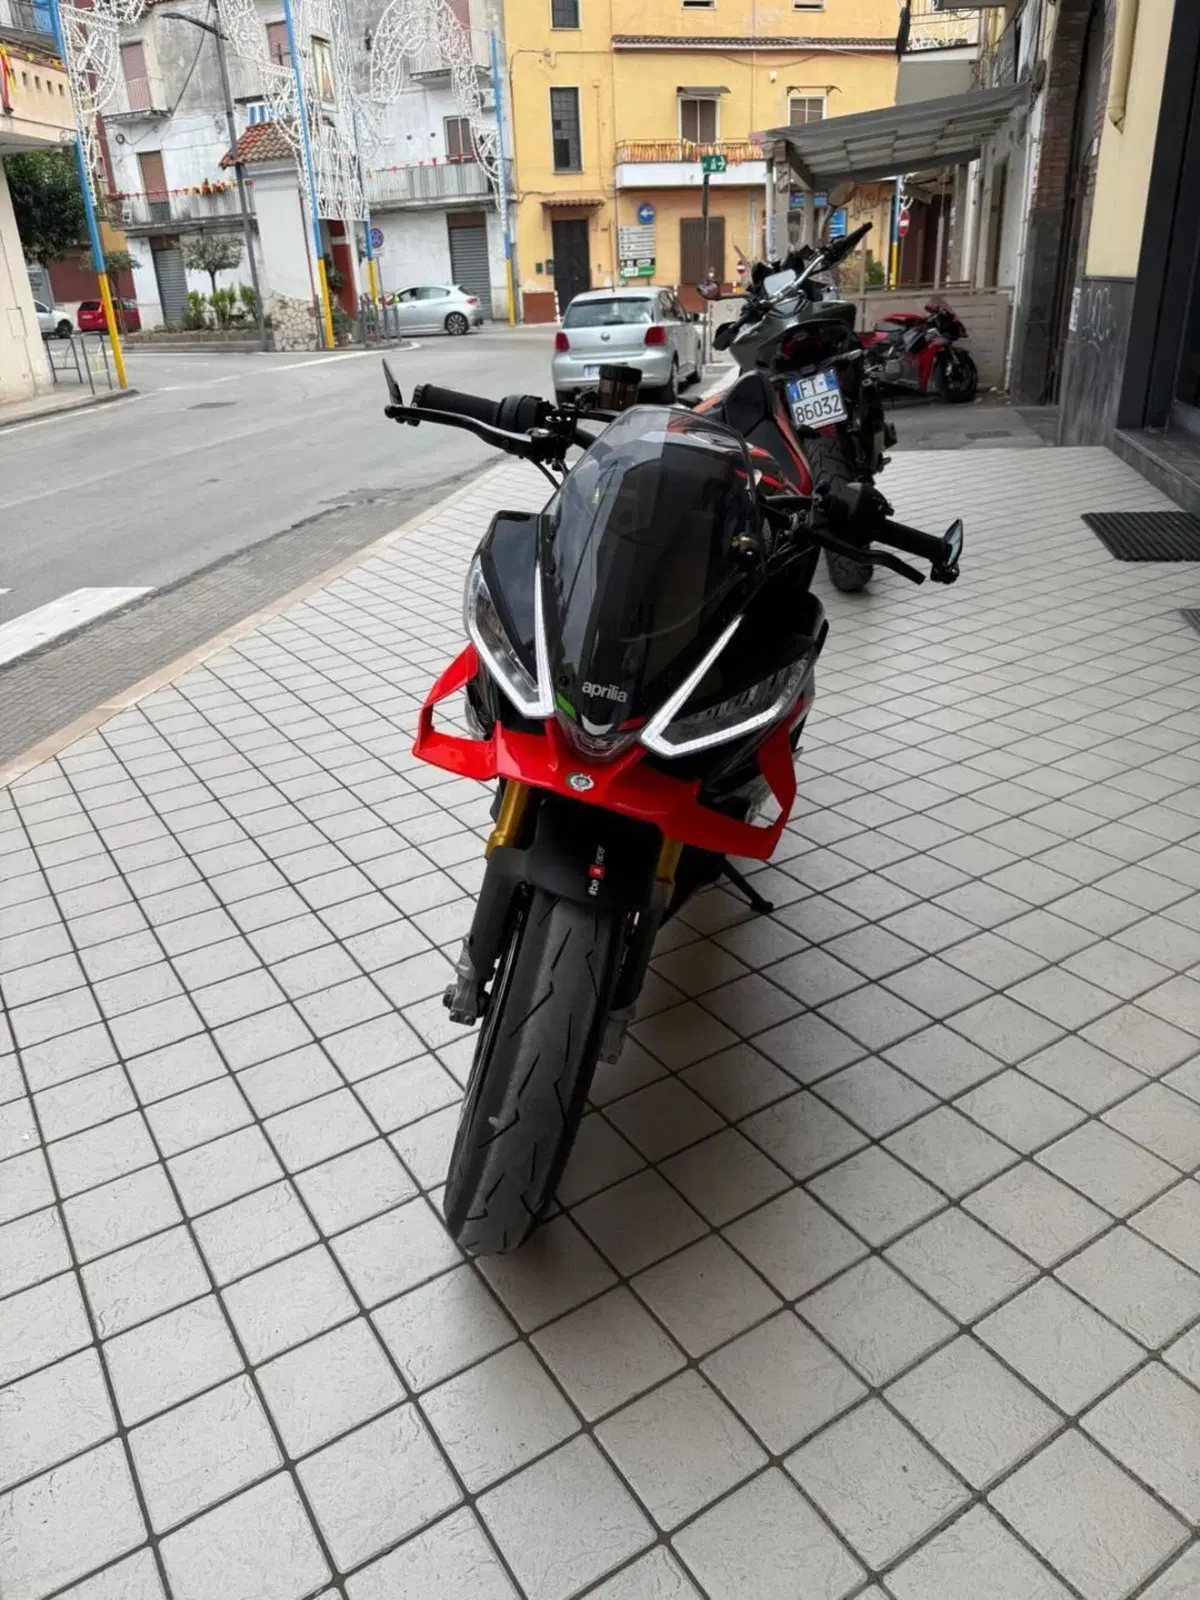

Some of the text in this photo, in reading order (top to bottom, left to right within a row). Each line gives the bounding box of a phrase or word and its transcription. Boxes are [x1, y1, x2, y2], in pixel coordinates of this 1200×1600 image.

[798, 377, 817, 398] FT
[795, 394, 841, 423] 86032
[581, 681, 628, 703] aprilia
